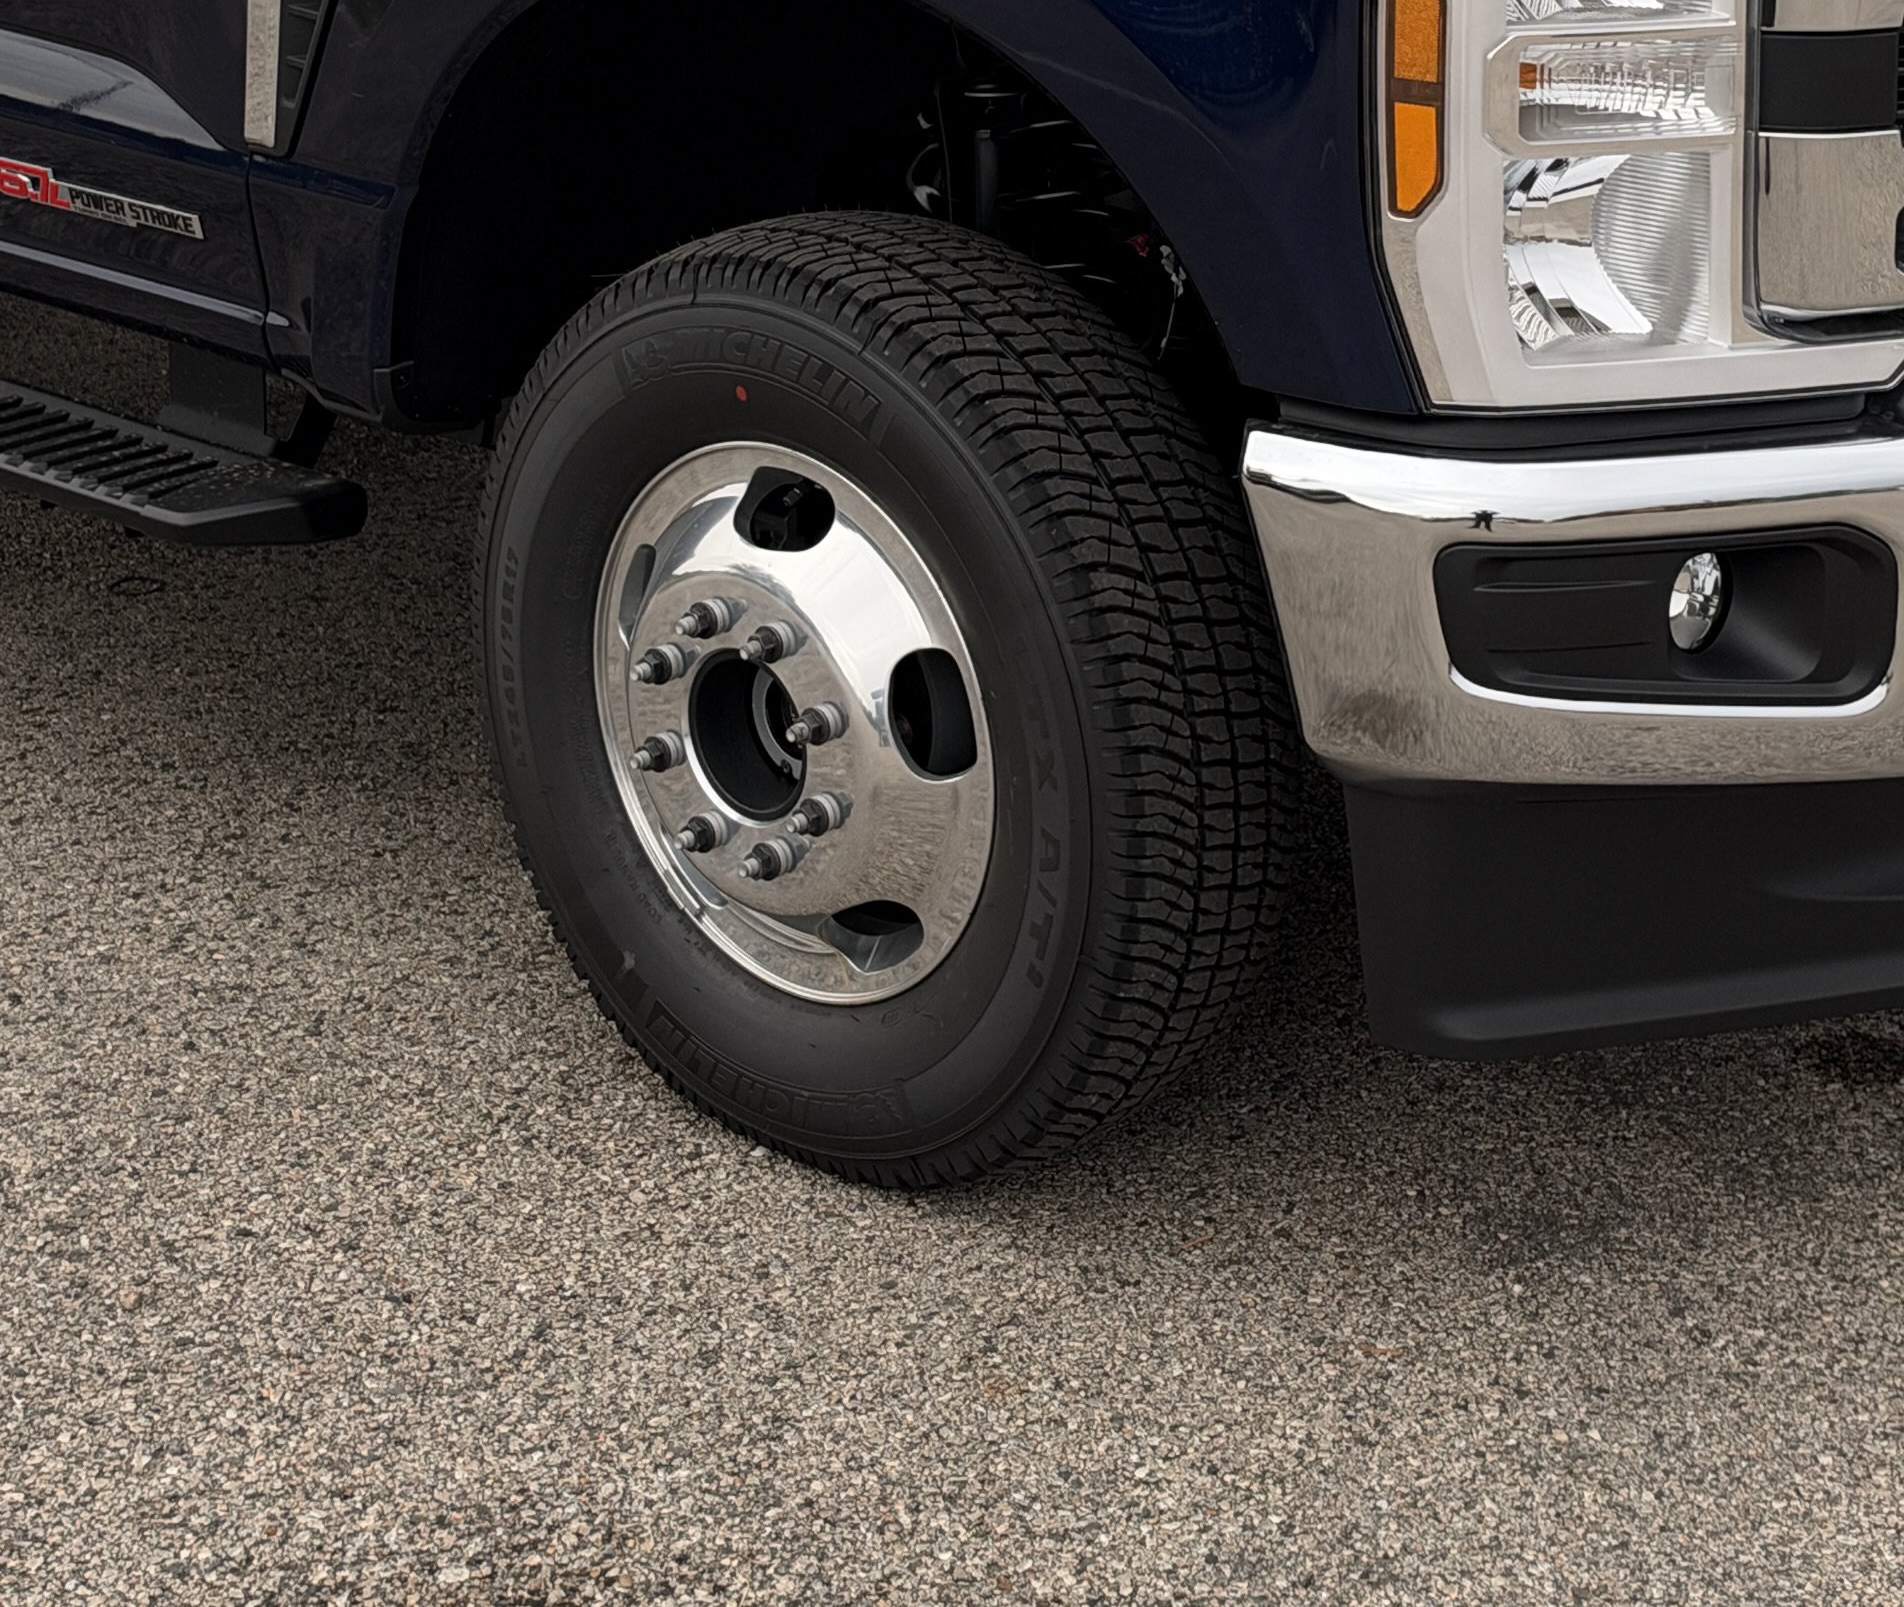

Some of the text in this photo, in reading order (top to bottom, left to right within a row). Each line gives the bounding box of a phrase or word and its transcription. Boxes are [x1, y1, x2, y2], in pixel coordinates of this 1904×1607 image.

[69, 186, 128, 219] POWER
[127, 201, 197, 234] STROKE
[672, 325, 883, 422] MICHELIN
